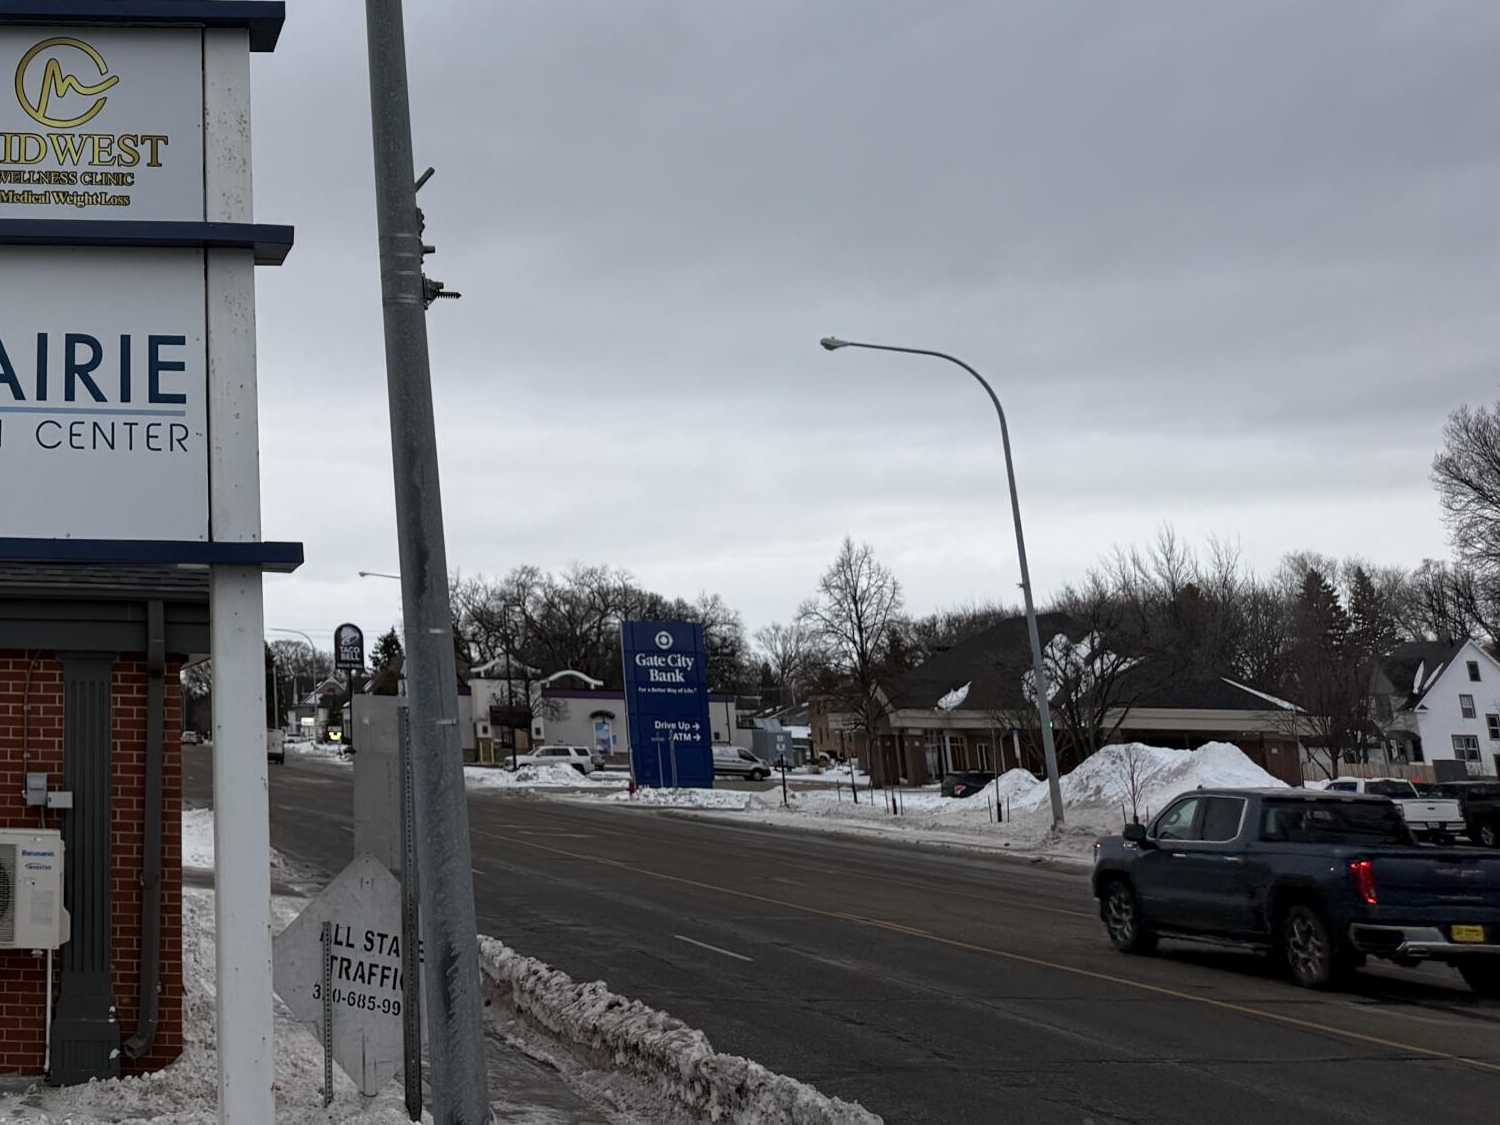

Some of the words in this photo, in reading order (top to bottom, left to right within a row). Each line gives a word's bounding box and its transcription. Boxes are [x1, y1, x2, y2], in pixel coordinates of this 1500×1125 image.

[81, 171, 135, 186] CLINIC
[53, 191, 100, 208] Weight
[100, 192, 130, 206] Loss
[35, 420, 189, 452] CENTER
[341, 652, 360, 660] BELL
[635, 653, 666, 667] Gate
[667, 654, 695, 671] City
[649, 669, 685, 683] Bank
[654, 720, 676, 729] Drive
[678, 721, 691, 731] Up
[673, 732, 691, 742] ATM
[320, 923, 355, 949] LL
[328, 955, 404, 991] TRAFFI
